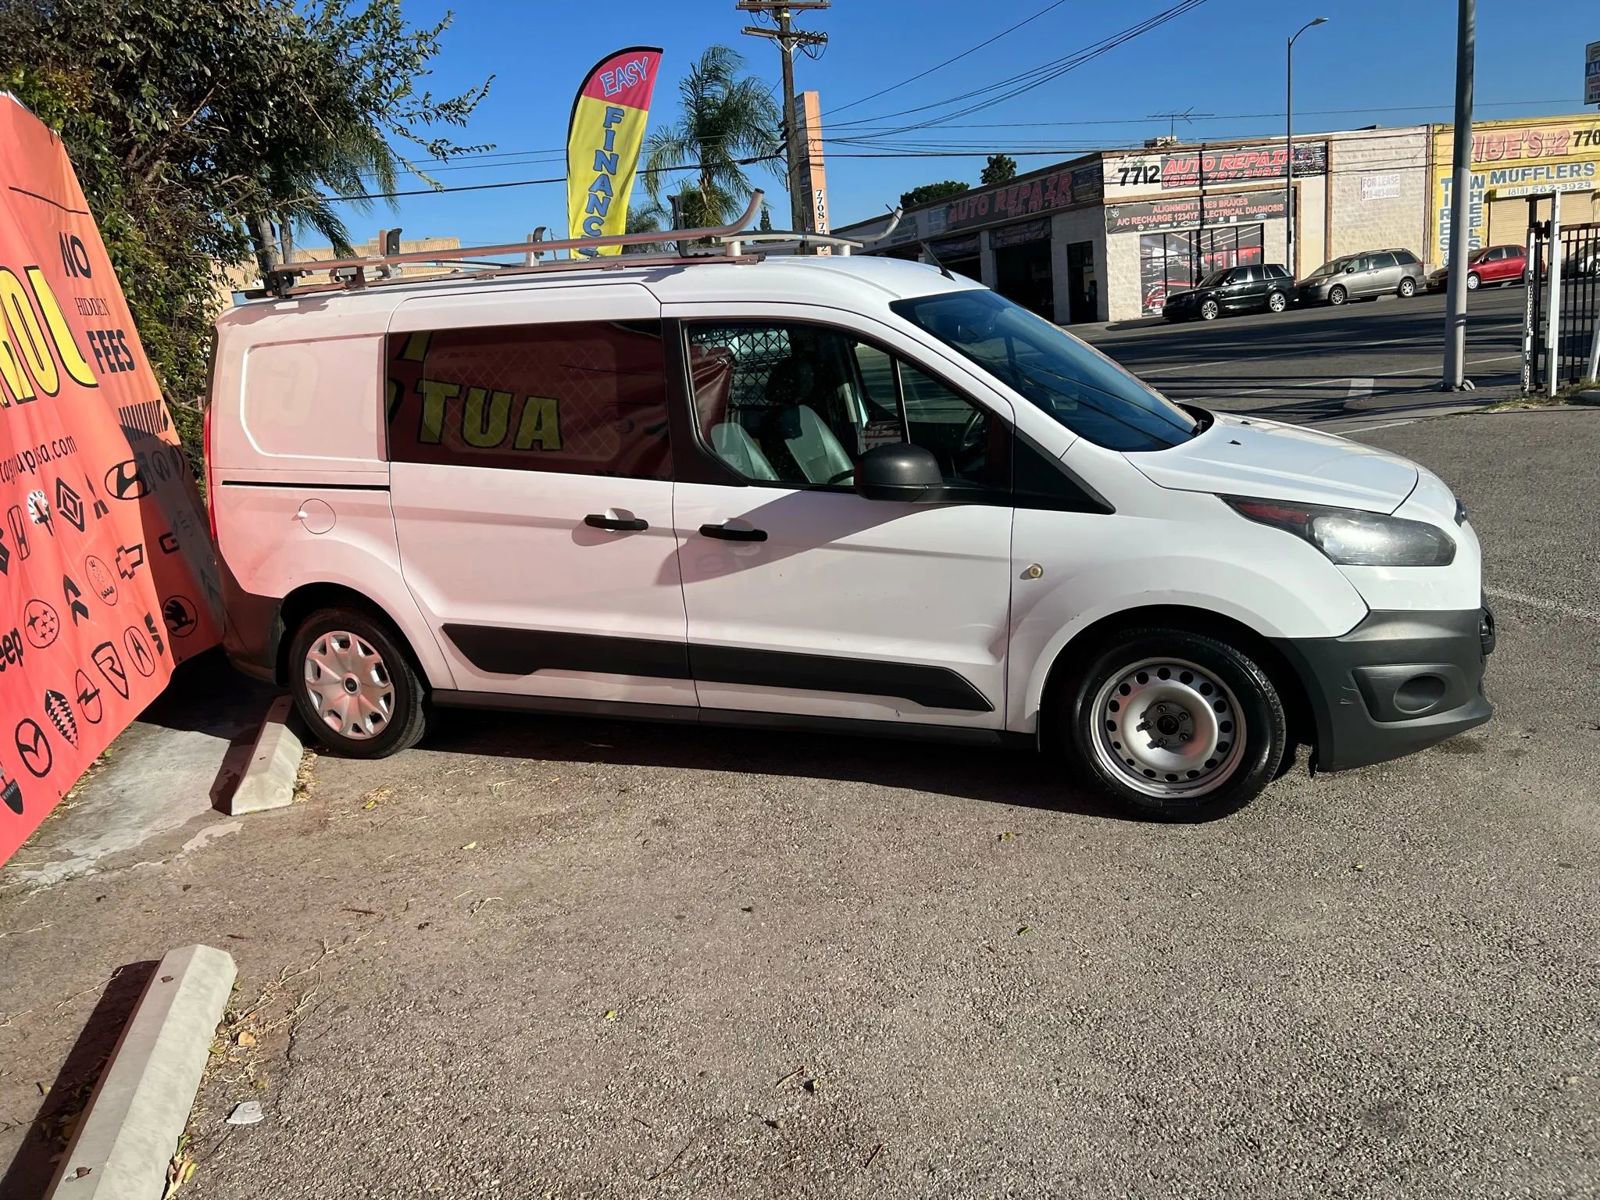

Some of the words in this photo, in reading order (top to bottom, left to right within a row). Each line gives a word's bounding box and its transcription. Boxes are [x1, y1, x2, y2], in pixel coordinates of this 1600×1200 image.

[600, 57, 649, 97] EASY
[1472, 129, 1544, 162] IBE'S
[1118, 165, 1161, 187] 7712
[1163, 156, 1216, 175] AUTO
[1490, 163, 1595, 185] MUFFLERS
[1363, 178, 1376, 188] FOR
[1378, 175, 1399, 186] LEASE
[816, 190, 825, 219] 7708
[948, 195, 989, 224] AUTO
[994, 173, 1073, 212] REPAIR
[1152, 203, 1195, 214] ALIGNMENT
[1195, 200, 1217, 211] TRES
[1219, 197, 1249, 208] BRAKES
[1468, 174, 1485, 251] WHEELS
[1116, 216, 1130, 226] A/C
[1131, 213, 1173, 225] RECHARGE
[1245, 203, 1284, 215] DIAGNOSIS
[1439, 178, 1452, 252] TIRES
[58, 232, 92, 279] NO
[74, 297, 110, 316] HIDDEN
[86, 329, 136, 375] FEES
